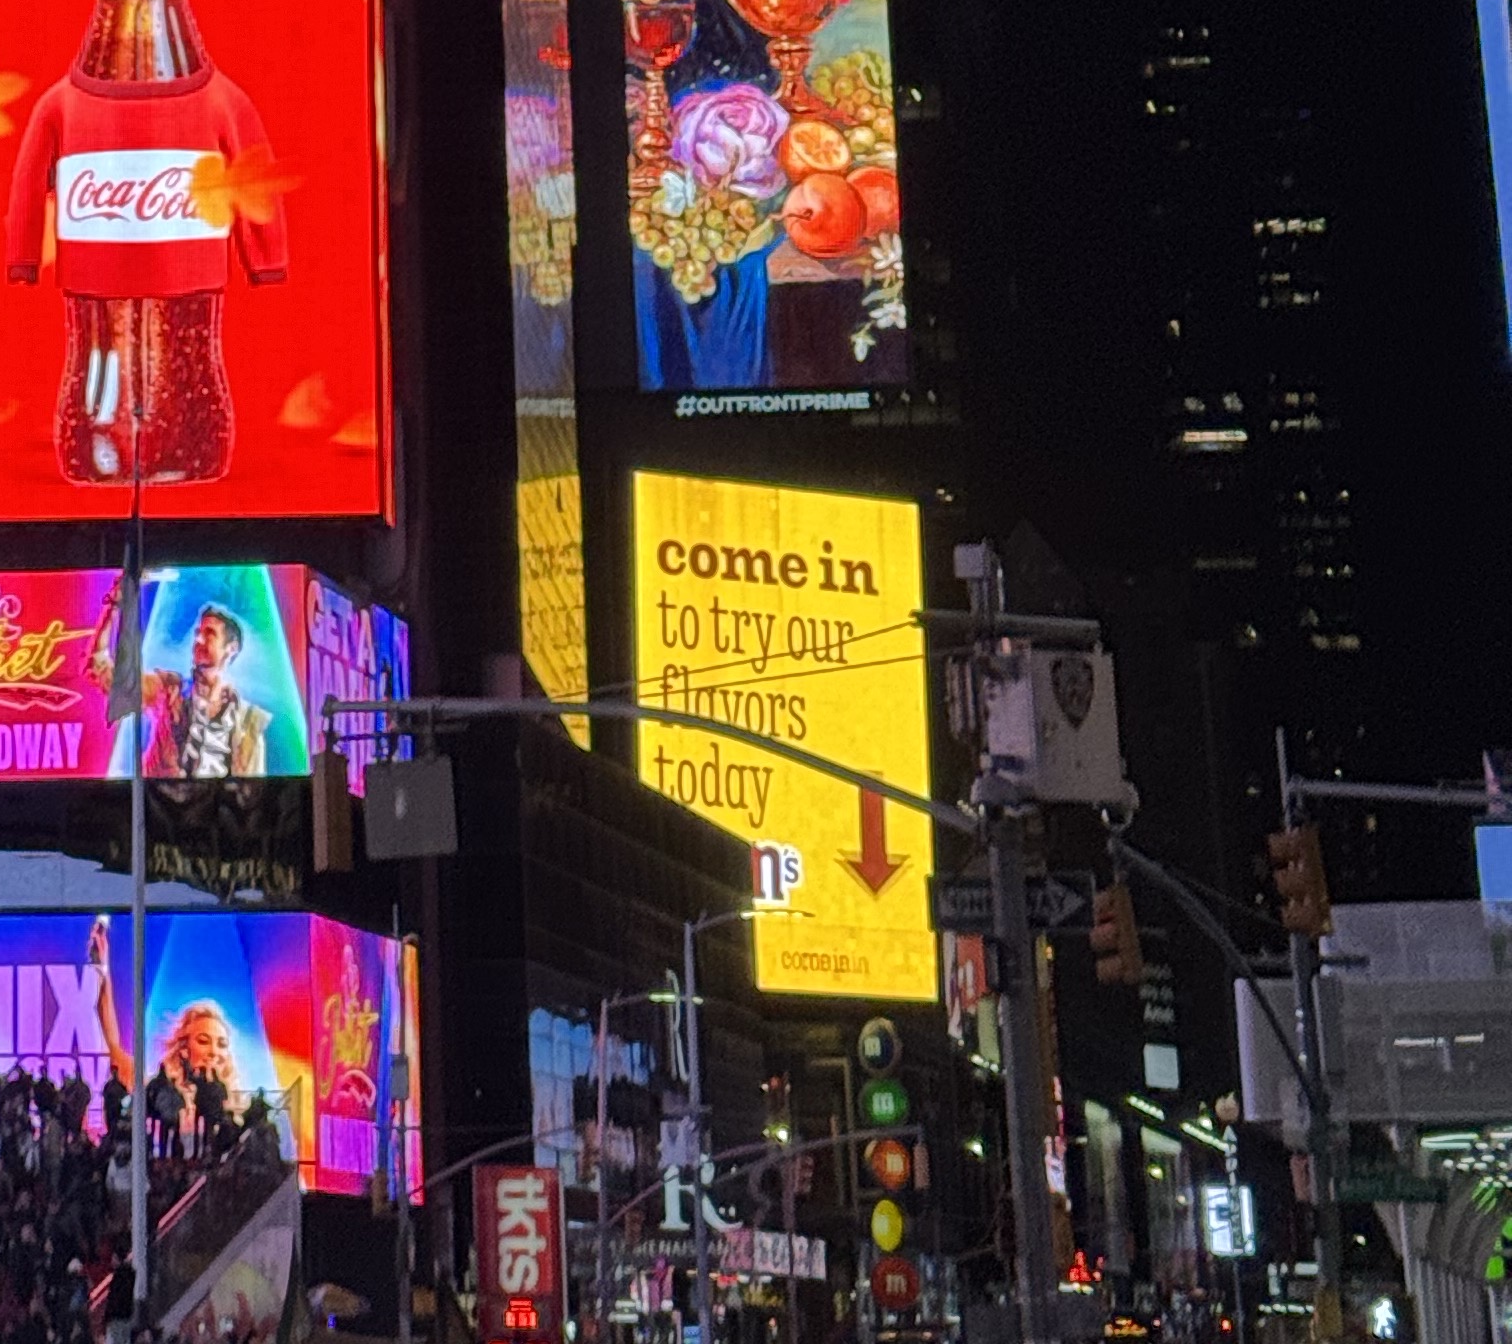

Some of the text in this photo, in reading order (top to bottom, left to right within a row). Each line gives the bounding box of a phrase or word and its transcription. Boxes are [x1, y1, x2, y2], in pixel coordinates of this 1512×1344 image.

[66, 166, 199, 222] Coca-Col
[675, 391, 870, 419] #OUTFRONTPRIME
[656, 538, 879, 597] come in
[656, 590, 854, 674] to try our
[659, 663, 807, 741] flavors
[653, 741, 774, 830] today
[496, 1172, 549, 1295] tkts
